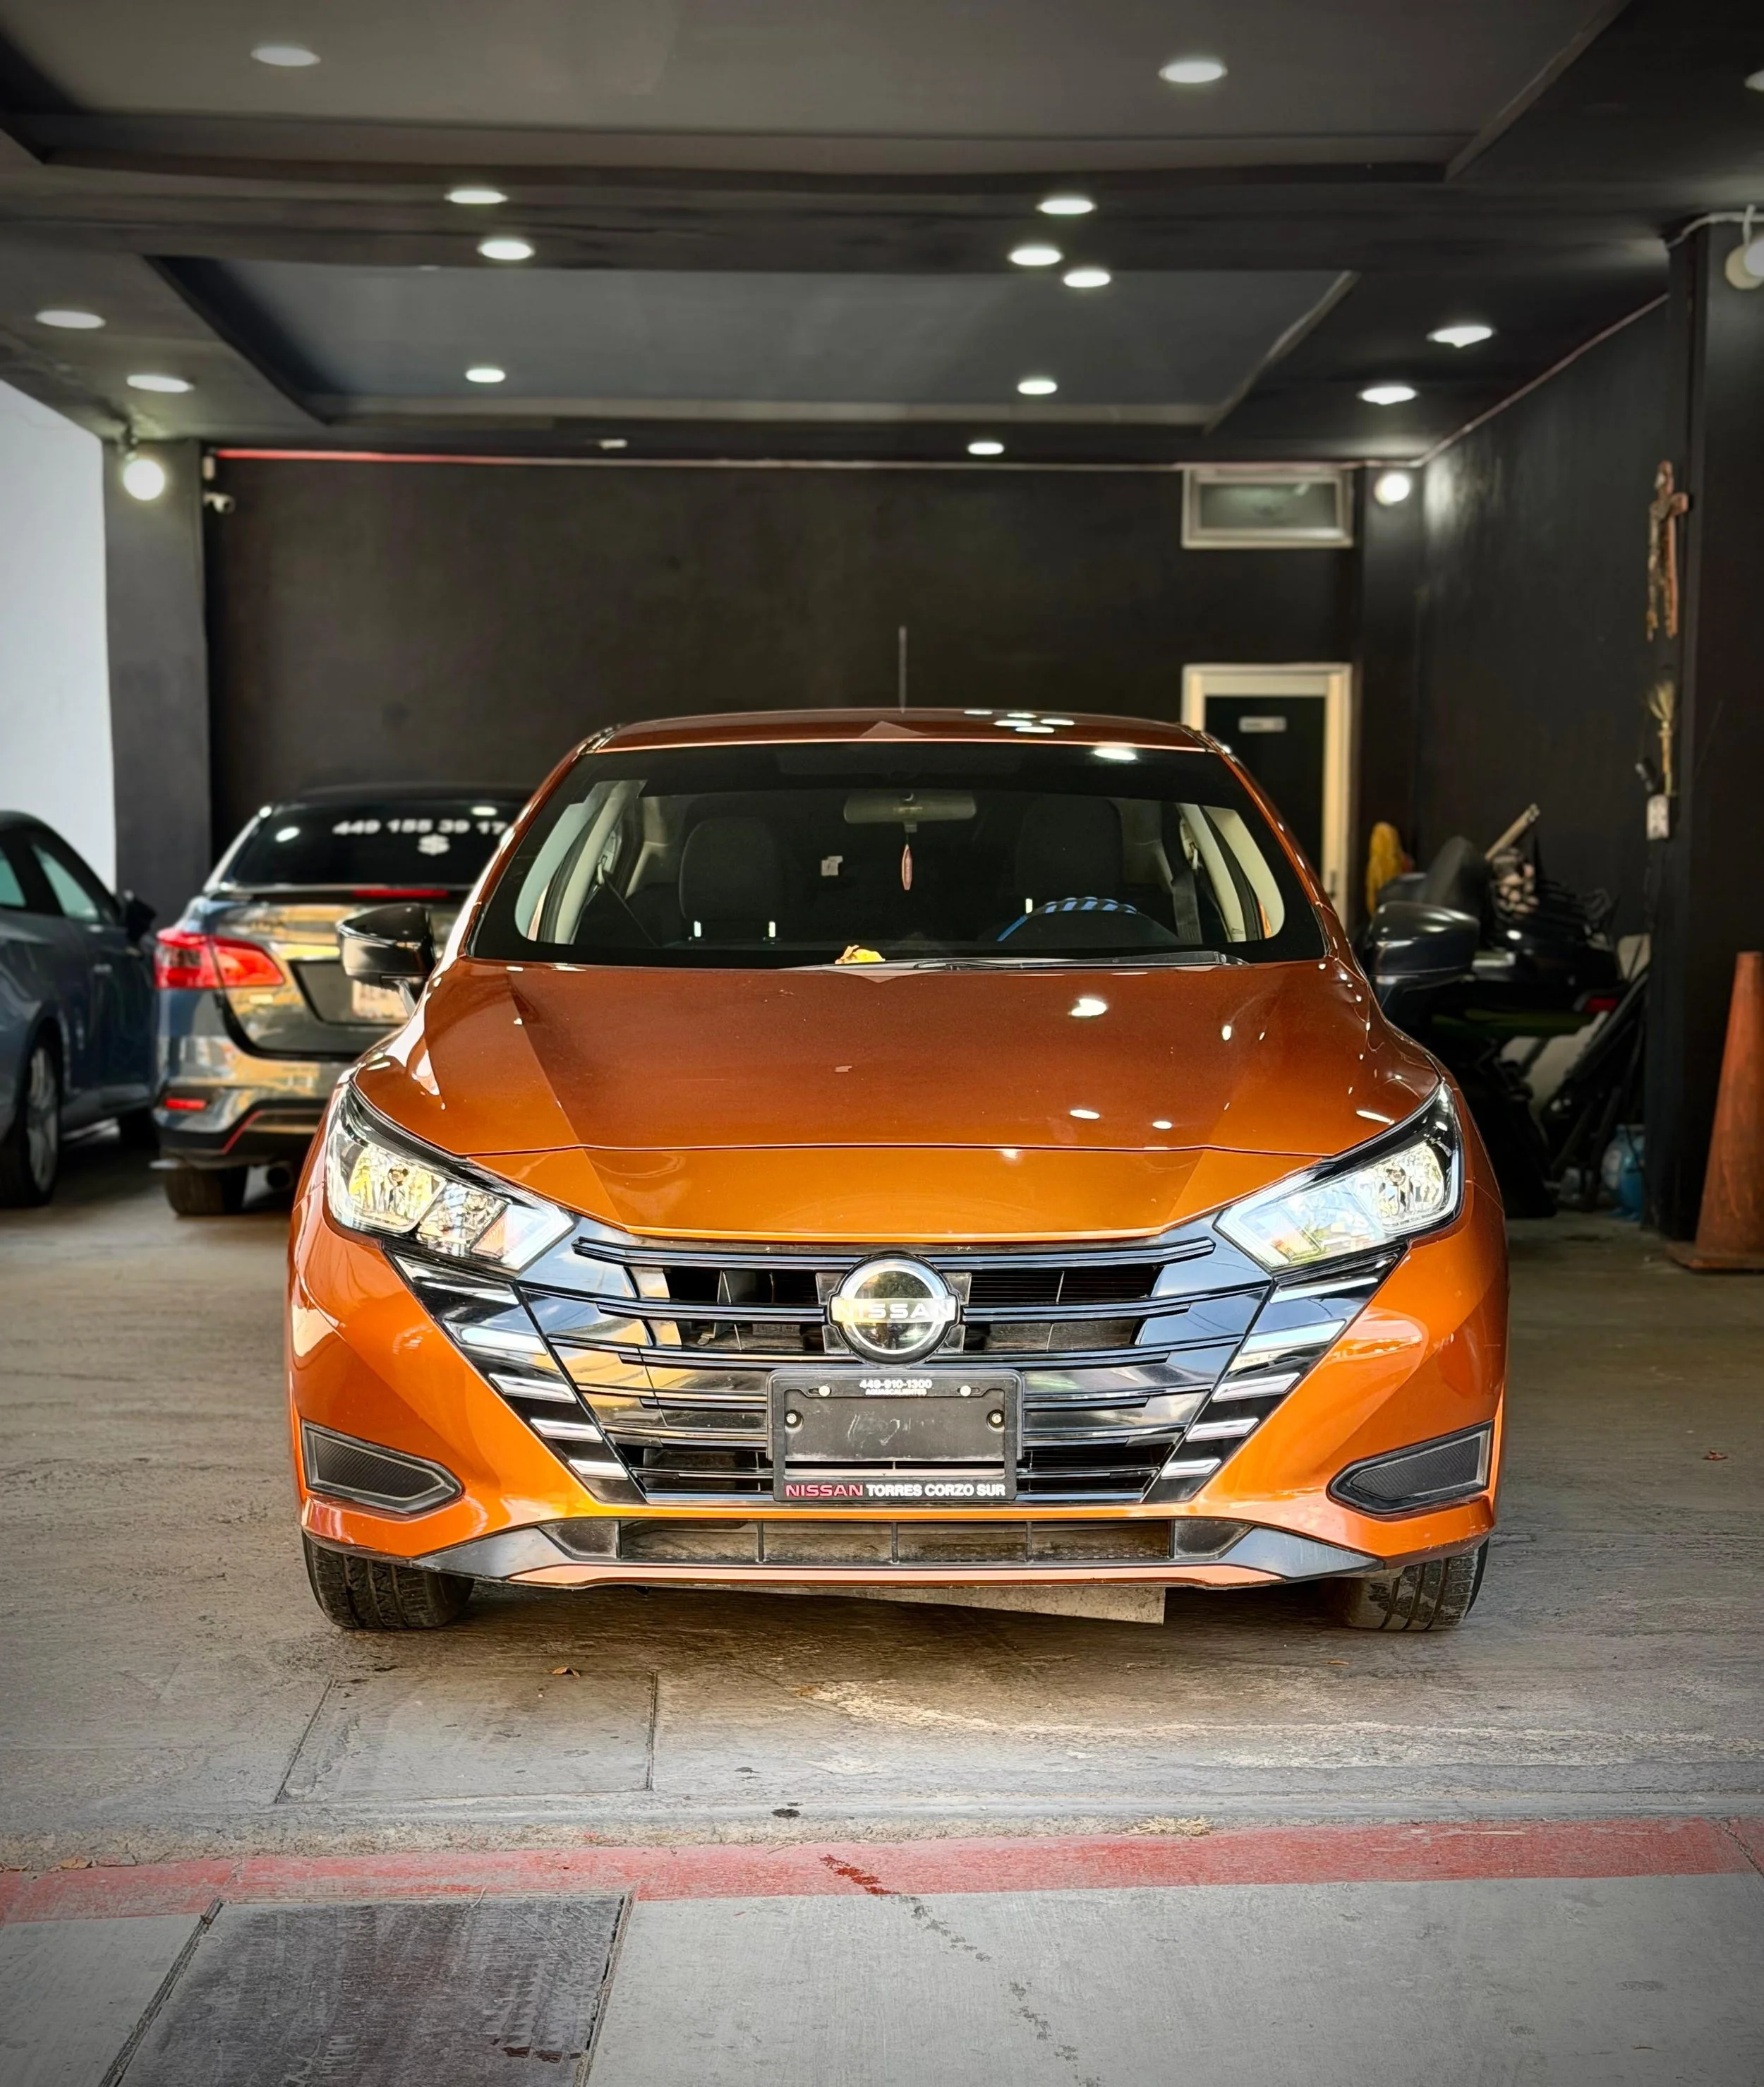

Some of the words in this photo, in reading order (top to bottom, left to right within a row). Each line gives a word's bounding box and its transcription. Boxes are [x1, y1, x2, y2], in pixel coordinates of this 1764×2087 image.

[332, 820, 381, 835] 449
[477, 820, 507, 834] 17
[838, 1303, 950, 1319] NISSAN
[859, 1379, 933, 1389] 449-910-1300
[785, 1484, 863, 1497] NISSAN
[866, 1484, 922, 1497] TORRES
[925, 1484, 974, 1497] CORZO
[977, 1484, 1006, 1497] SUR
